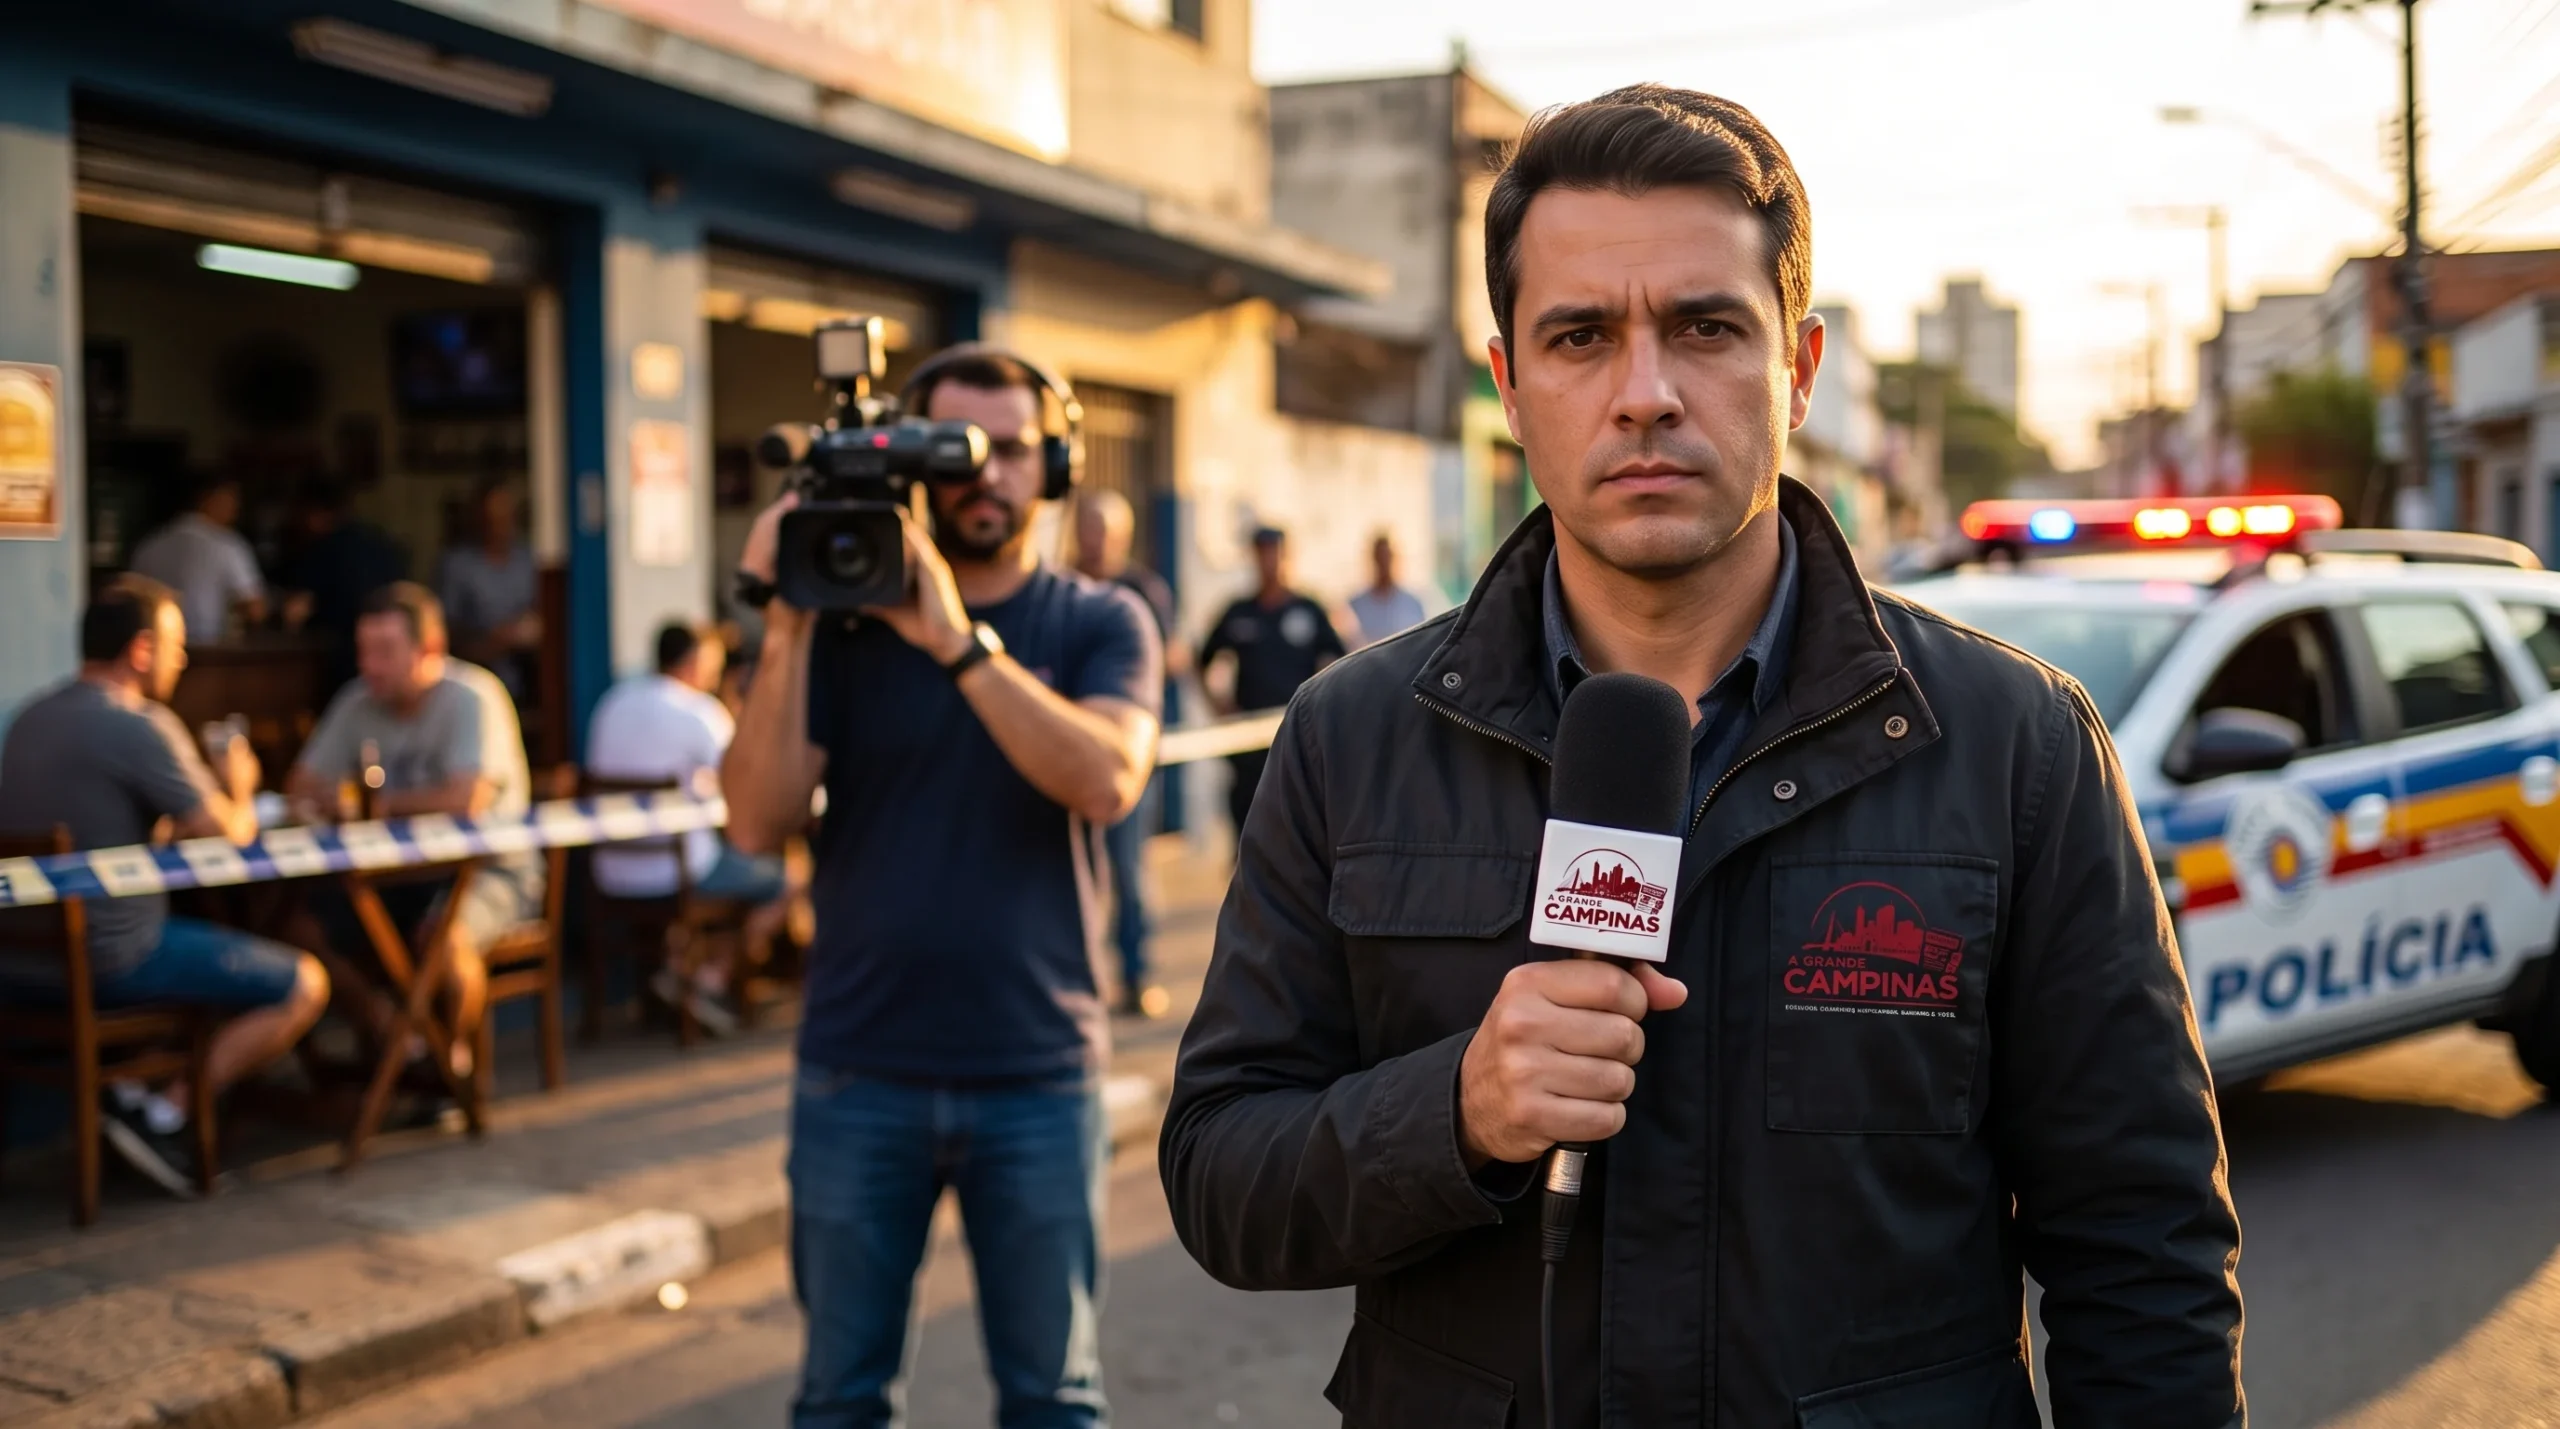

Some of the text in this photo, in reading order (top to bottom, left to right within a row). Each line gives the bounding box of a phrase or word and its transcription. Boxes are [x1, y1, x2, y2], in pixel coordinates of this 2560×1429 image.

[1558, 895, 1602, 907] GRANDE
[1544, 903, 1660, 933] CAMPINAS
[1788, 955, 1866, 968] A GRANDE
[2206, 904, 2496, 1024] POLÍCIA
[1784, 967, 1958, 999] CAMPINAS
